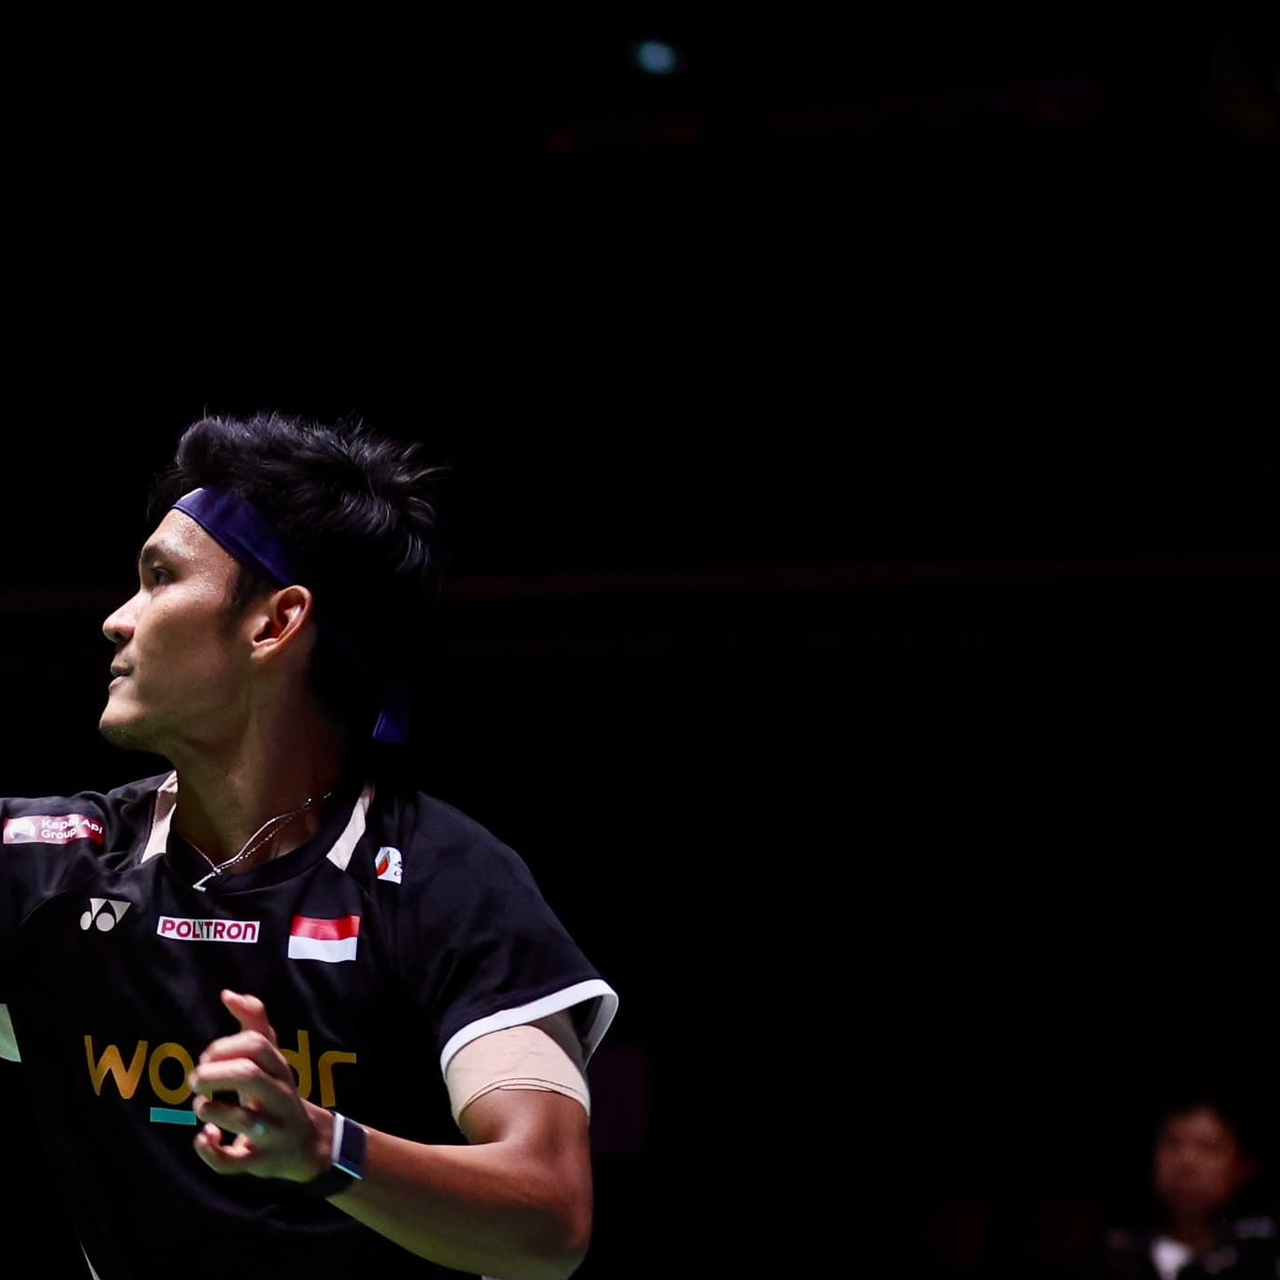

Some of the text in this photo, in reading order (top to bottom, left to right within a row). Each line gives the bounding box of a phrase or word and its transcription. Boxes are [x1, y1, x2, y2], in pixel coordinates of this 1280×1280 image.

[41, 818, 78, 831] Kapal
[41, 828, 77, 840] Group
[161, 919, 256, 940] POLYTRON
[83, 1030, 357, 1108] wodr
